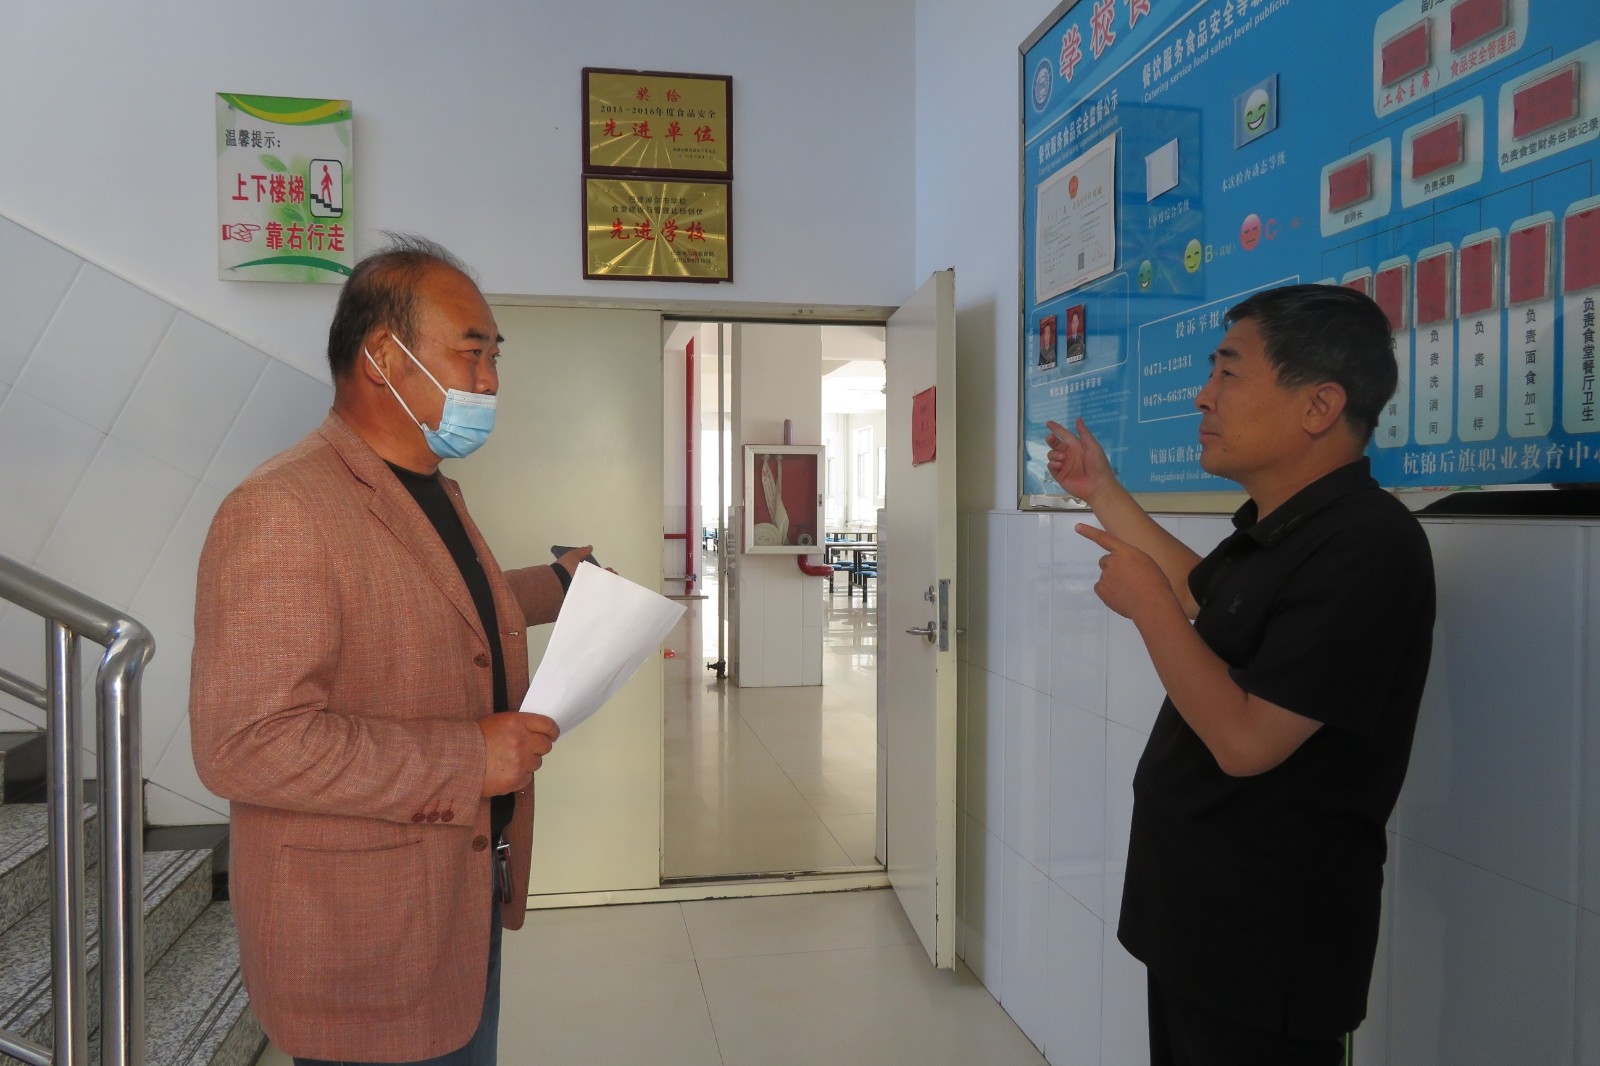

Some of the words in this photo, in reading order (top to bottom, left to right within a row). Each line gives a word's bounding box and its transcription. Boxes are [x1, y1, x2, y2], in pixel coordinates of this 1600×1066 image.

[1144, 80, 1169, 103] Catering
[1170, 61, 1192, 85] service
[1193, 52, 1209, 69] food
[1210, 34, 1233, 56] safety
[1234, 19, 1252, 39] level
[1450, 30, 1517, 78] 食品安全管理员
[225, 129, 281, 149] 温馨提示：
[603, 119, 715, 143] 先进单位
[1500, 117, 1599, 167] 负责食堂财务台账记录
[232, 173, 305, 205] 上下楼梯
[1423, 174, 1455, 195] 负责采购
[265, 222, 345, 252] 靠右行走
[610, 218, 706, 243] 先进学校
[1143, 354, 1192, 377] 0471-12331
[1524, 308, 1537, 427] 负责面食加工
[1581, 297, 1595, 422] 负责食堂餐厅卫生
[1472, 320, 1485, 431] 负责留样
[1186, 470, 1200, 480] food
